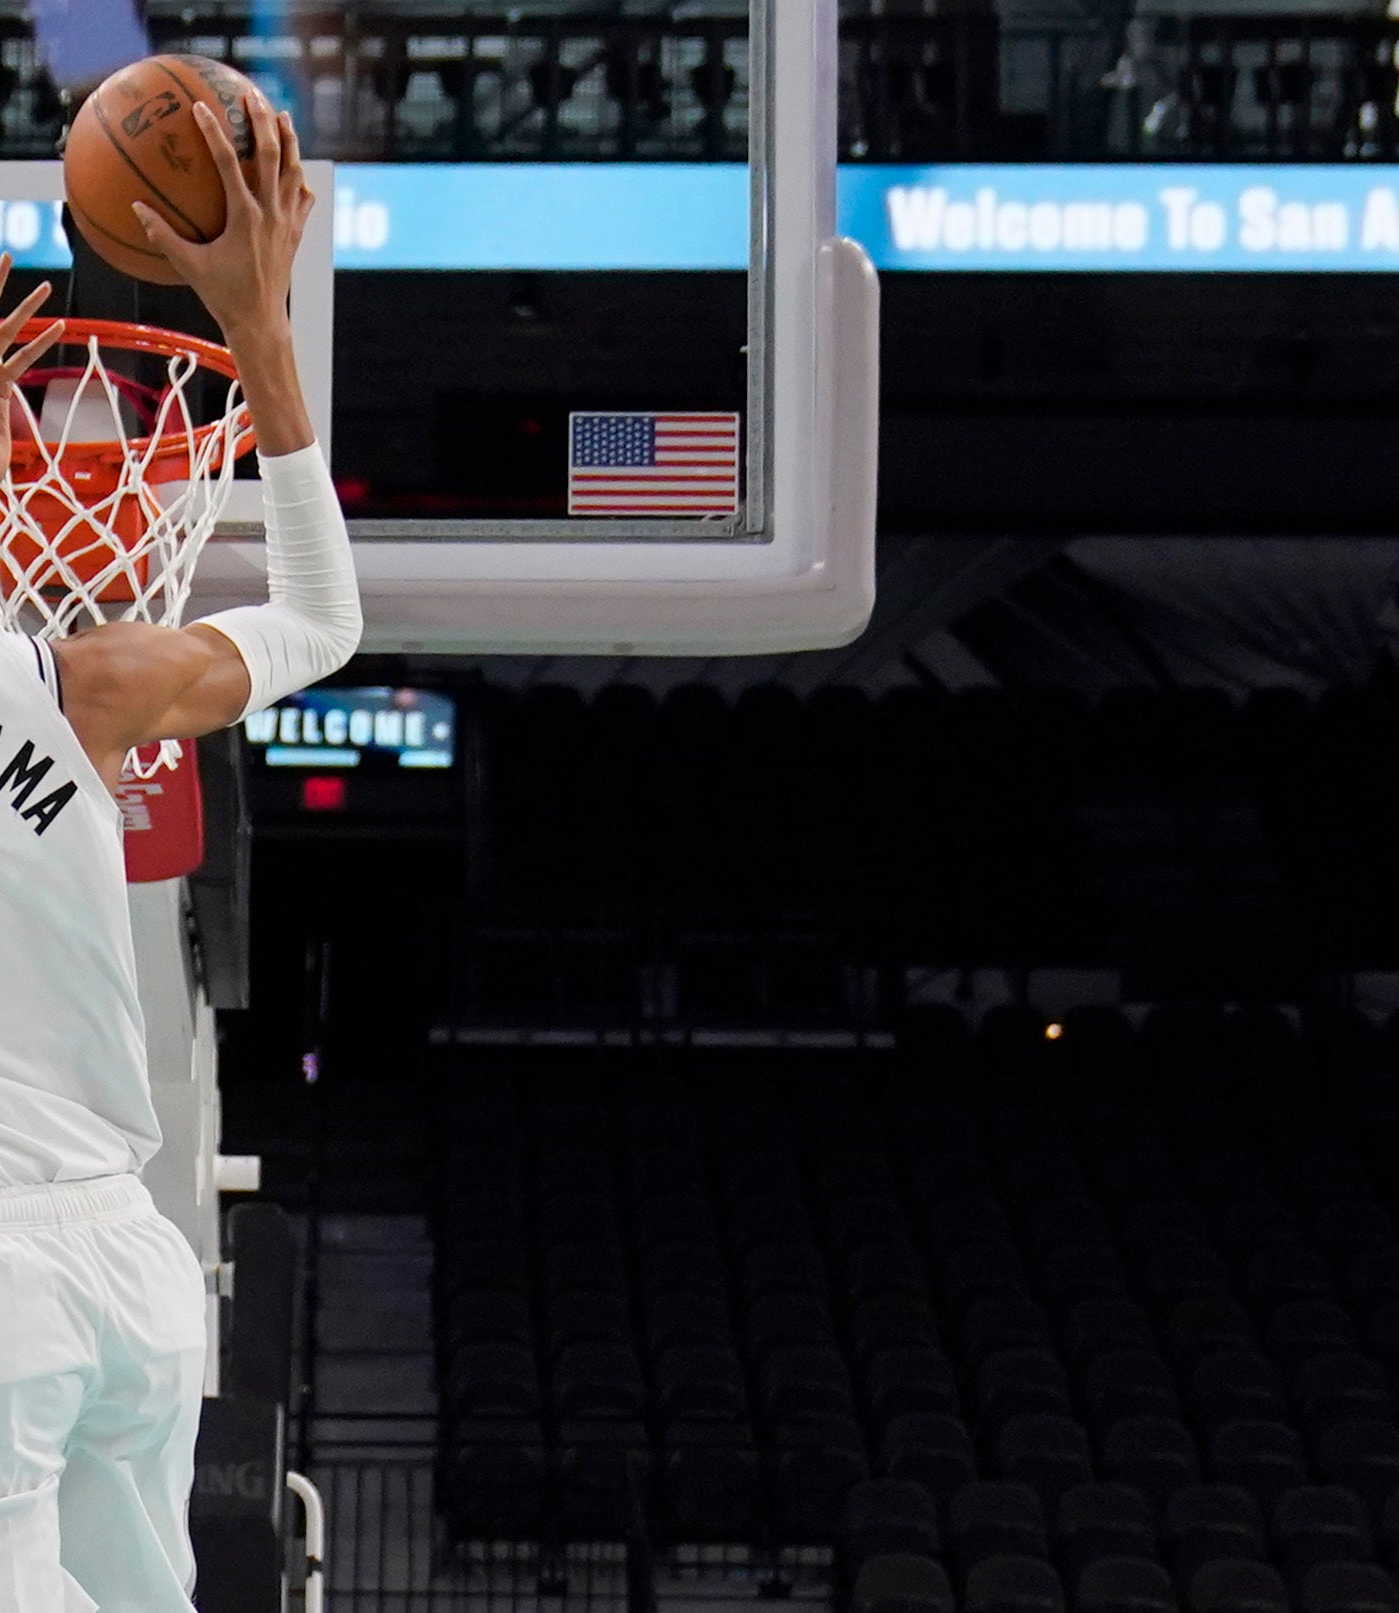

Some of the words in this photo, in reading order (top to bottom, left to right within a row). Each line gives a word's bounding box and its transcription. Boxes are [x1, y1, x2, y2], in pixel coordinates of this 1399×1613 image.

[888, 186, 1148, 252] Welcome
[1159, 186, 1227, 252] To
[1239, 185, 1349, 251] San
[244, 707, 426, 746] WELCOME
